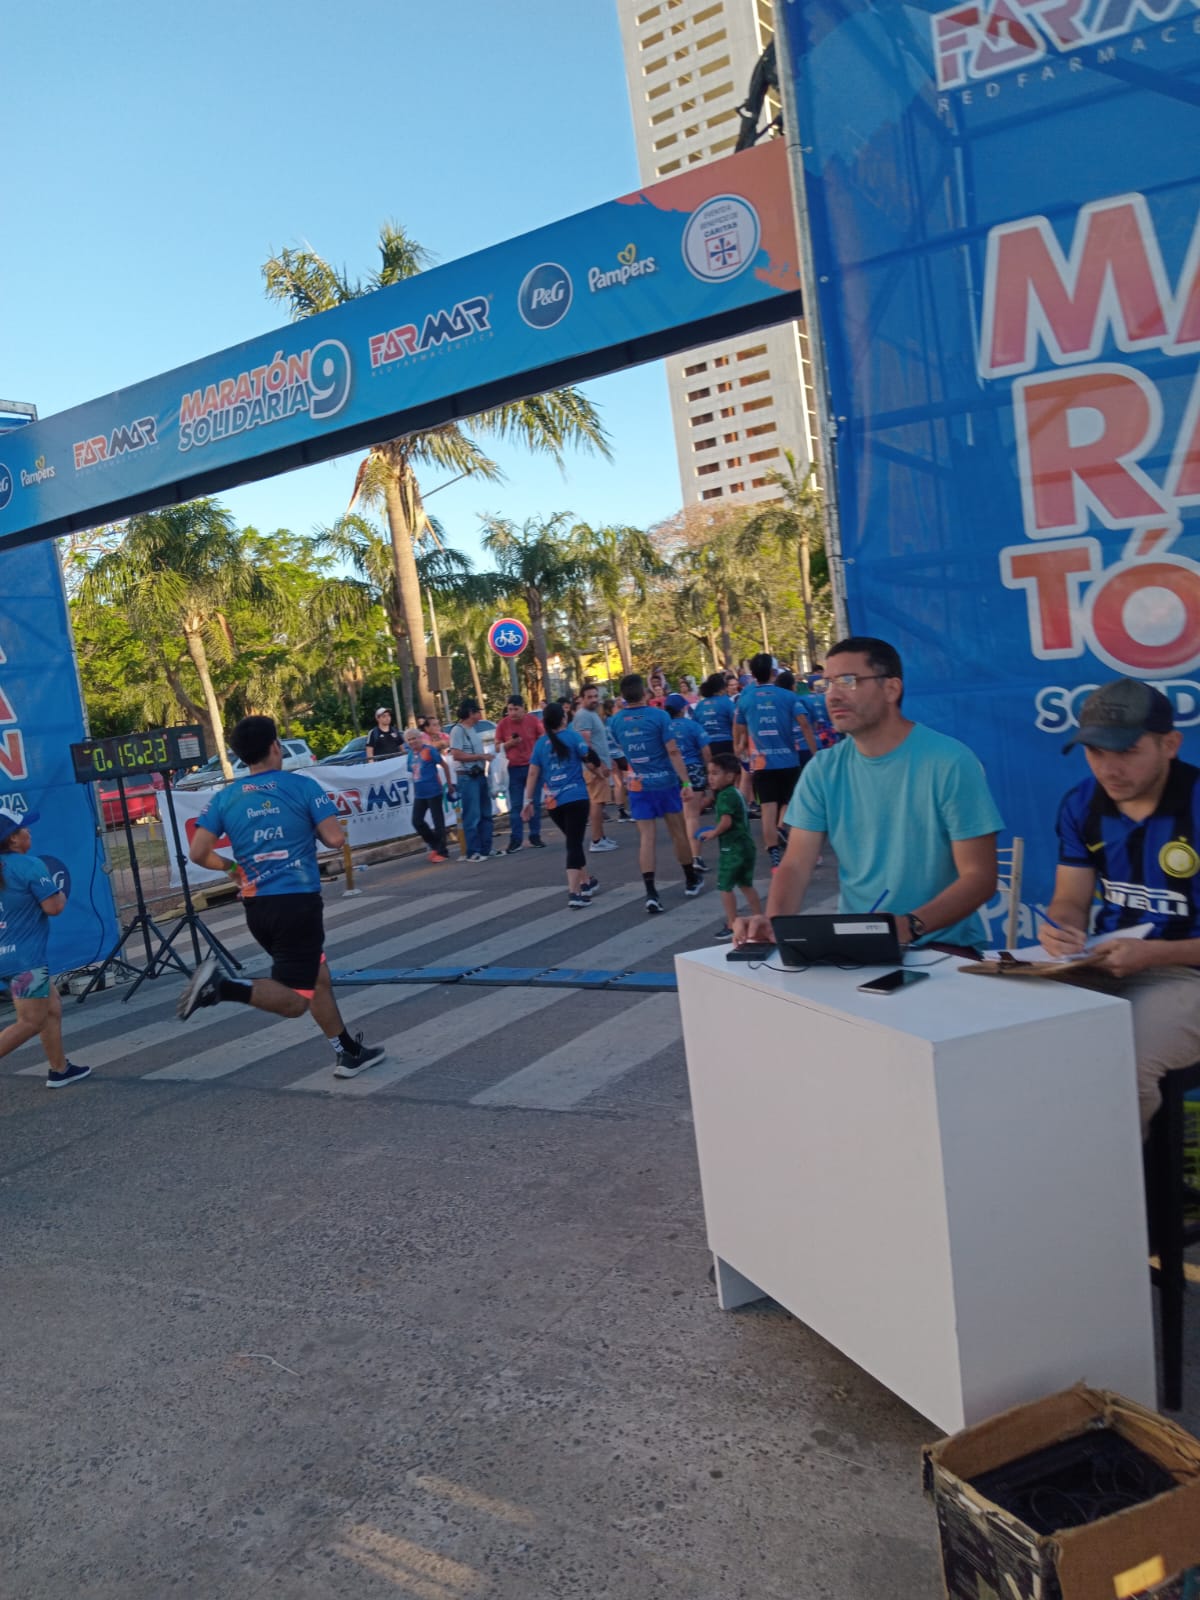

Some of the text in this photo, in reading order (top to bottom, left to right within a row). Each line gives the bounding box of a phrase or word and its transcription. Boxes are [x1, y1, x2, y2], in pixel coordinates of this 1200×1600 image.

[937, 82, 1000, 114] RED
[588, 256, 656, 292] Pampers
[531, 280, 565, 310] P&G
[369, 295, 491, 368] FARMAR
[181, 338, 352, 425] MARATÓN 9
[177, 380, 310, 452] SOLIDARIA
[73, 415, 158, 471] FARMAR
[20, 465, 56, 487] Pampers
[253, 825, 284, 843] PGA
